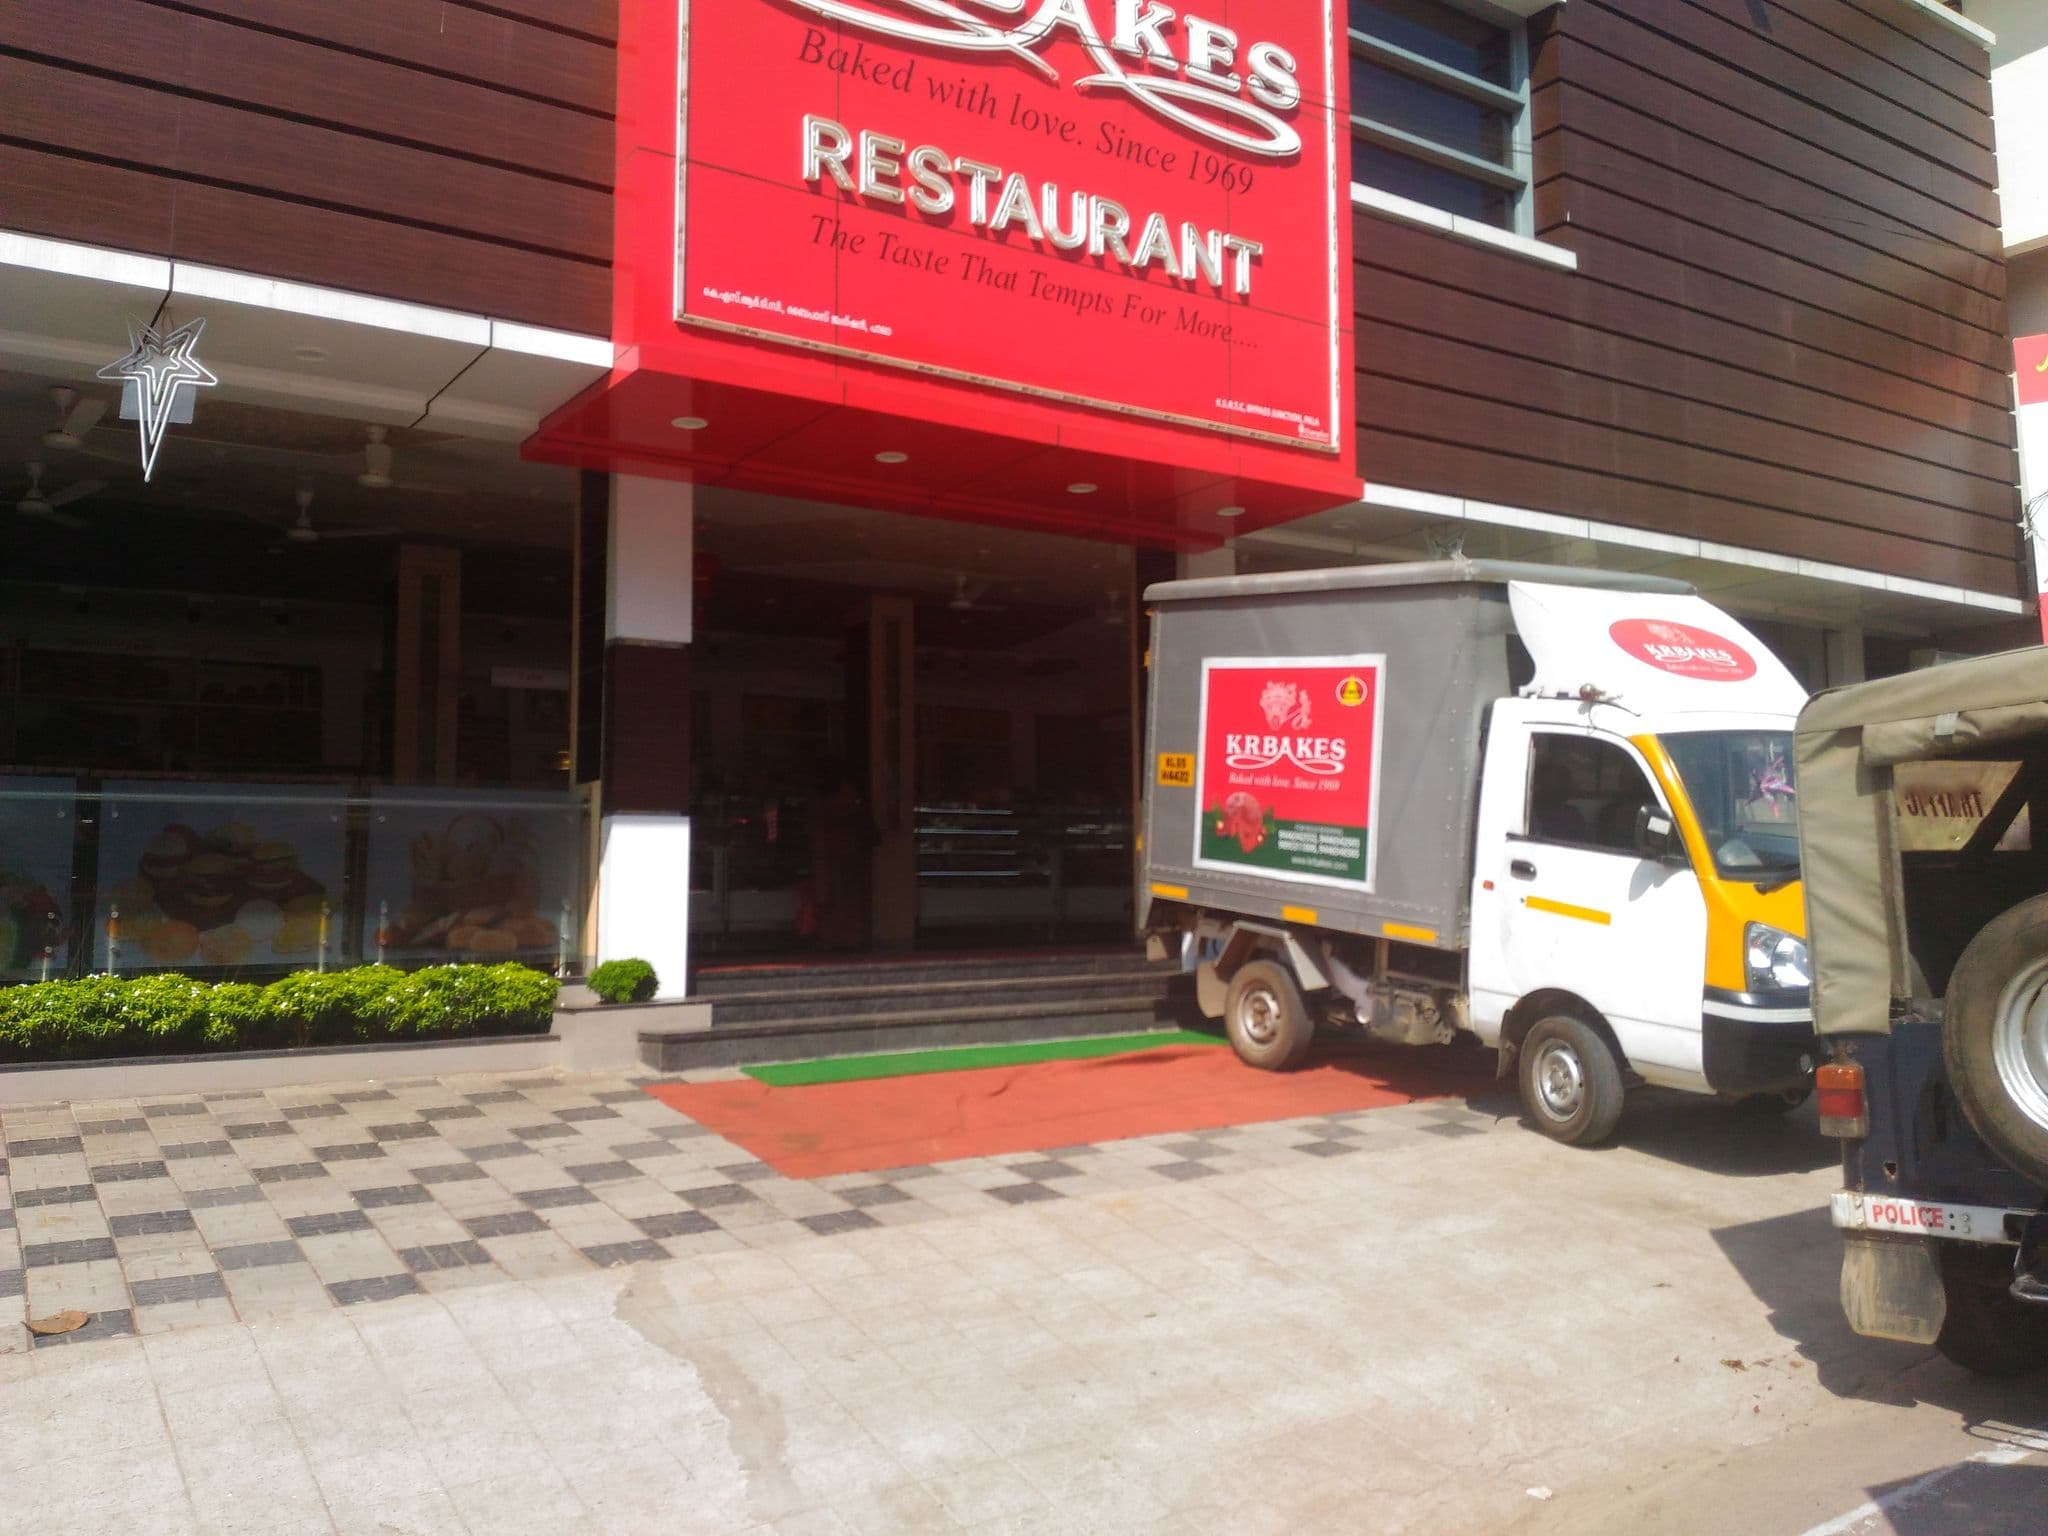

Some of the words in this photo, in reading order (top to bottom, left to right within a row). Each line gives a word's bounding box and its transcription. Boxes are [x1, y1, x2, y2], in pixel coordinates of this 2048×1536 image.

[799, 28, 915, 94] Baked
[926, 73, 997, 120] with
[1010, 94, 1083, 145] love.
[1097, 121, 1175, 173] Since
[1188, 146, 1255, 196] 1969
[802, 114, 1265, 296] RESTAURANT
[810, 214, 864, 254] The
[879, 231, 949, 275] Taste
[961, 252, 1017, 292] That
[1028, 270, 1114, 317] Tempts
[1123, 294, 1166, 327] For
[1642, 642, 1736, 667] KRBAKES
[1225, 733, 1346, 767] KRBAKES
[1872, 1203, 1946, 1229] POLICE
